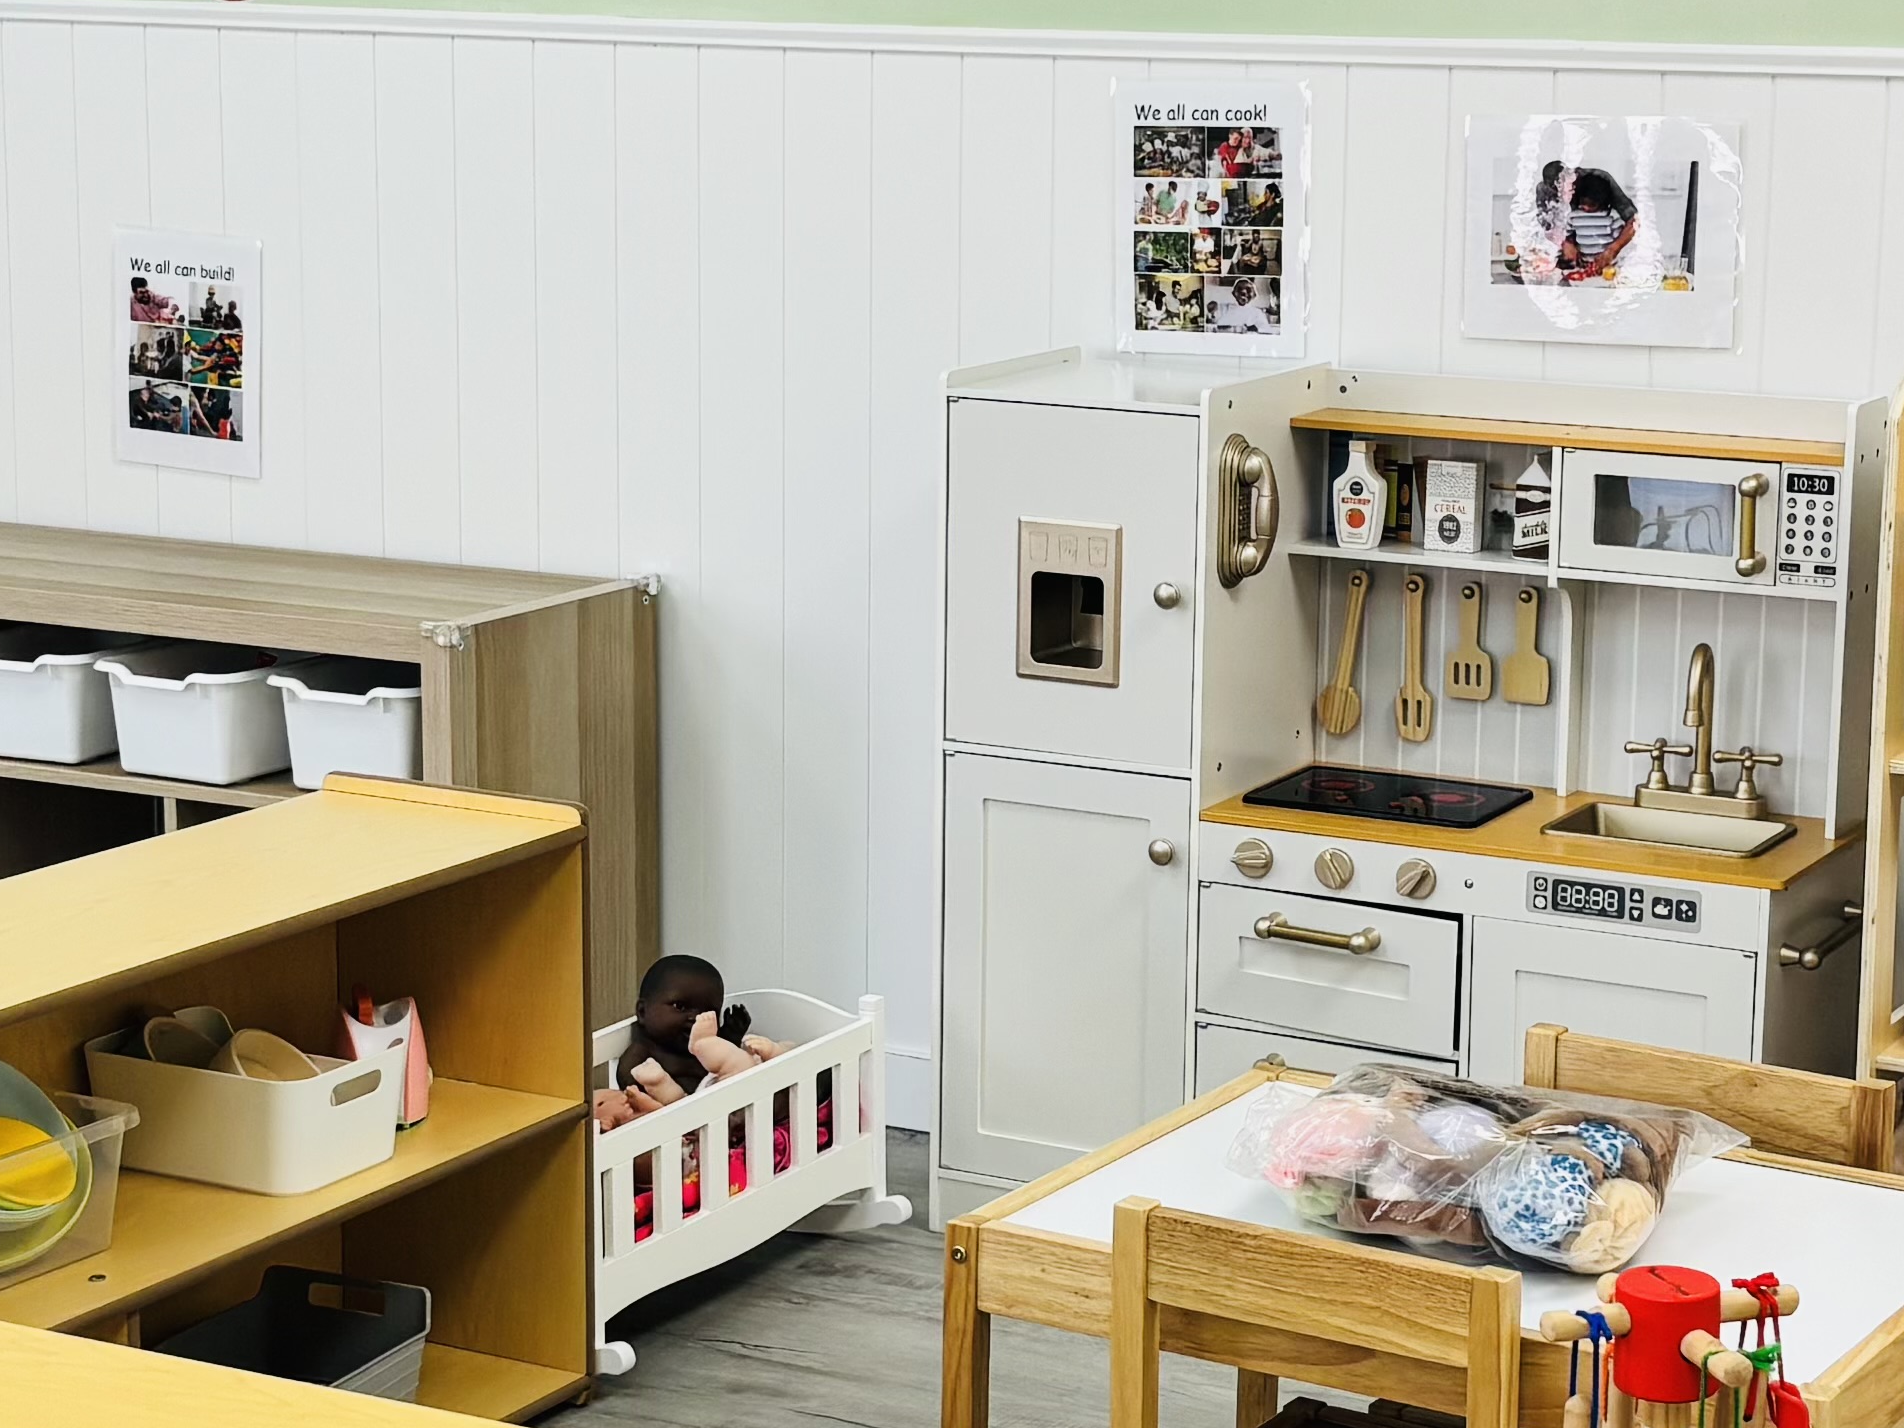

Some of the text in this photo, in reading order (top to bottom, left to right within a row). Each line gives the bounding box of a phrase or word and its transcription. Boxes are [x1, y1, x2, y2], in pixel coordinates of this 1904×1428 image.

[1134, 103, 1267, 122] We all can cook!
[130, 256, 235, 282] We all can build!
[1792, 476, 1829, 492] 10:30
[1434, 503, 1467, 515] CEREAL
[1521, 524, 1549, 539] MILK
